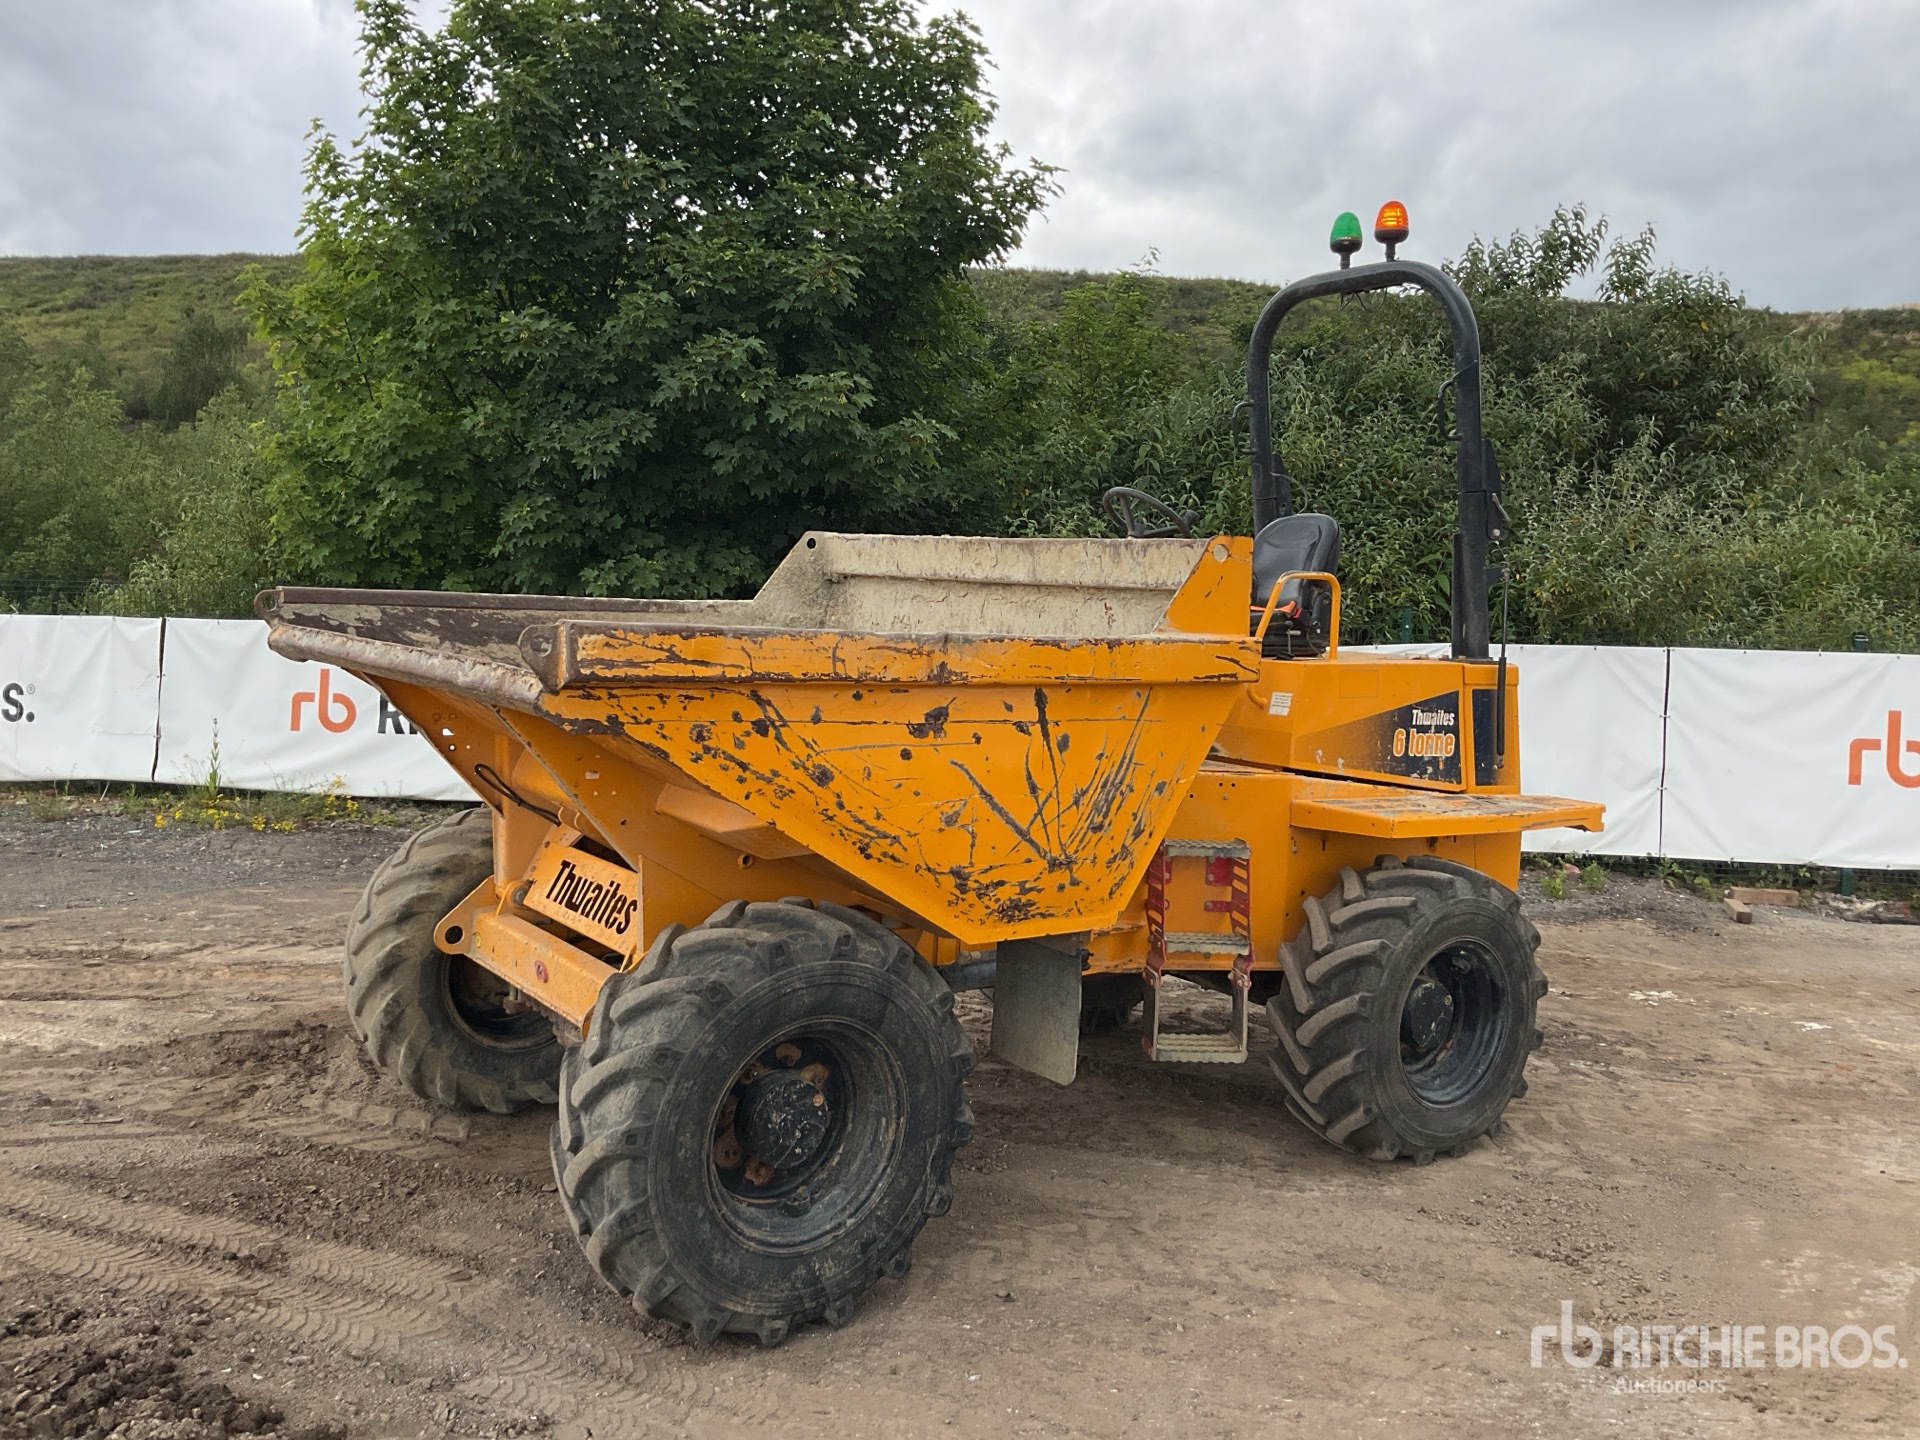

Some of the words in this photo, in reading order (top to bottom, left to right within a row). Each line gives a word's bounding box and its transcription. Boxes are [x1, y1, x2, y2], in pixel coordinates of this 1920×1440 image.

[290, 669, 356, 733] rb
[378, 694, 418, 734] R
[1412, 709, 1455, 726] Thwaites
[1393, 728, 1406, 757] 6
[1408, 728, 1456, 757] tonne
[545, 859, 638, 935] Thwaites
